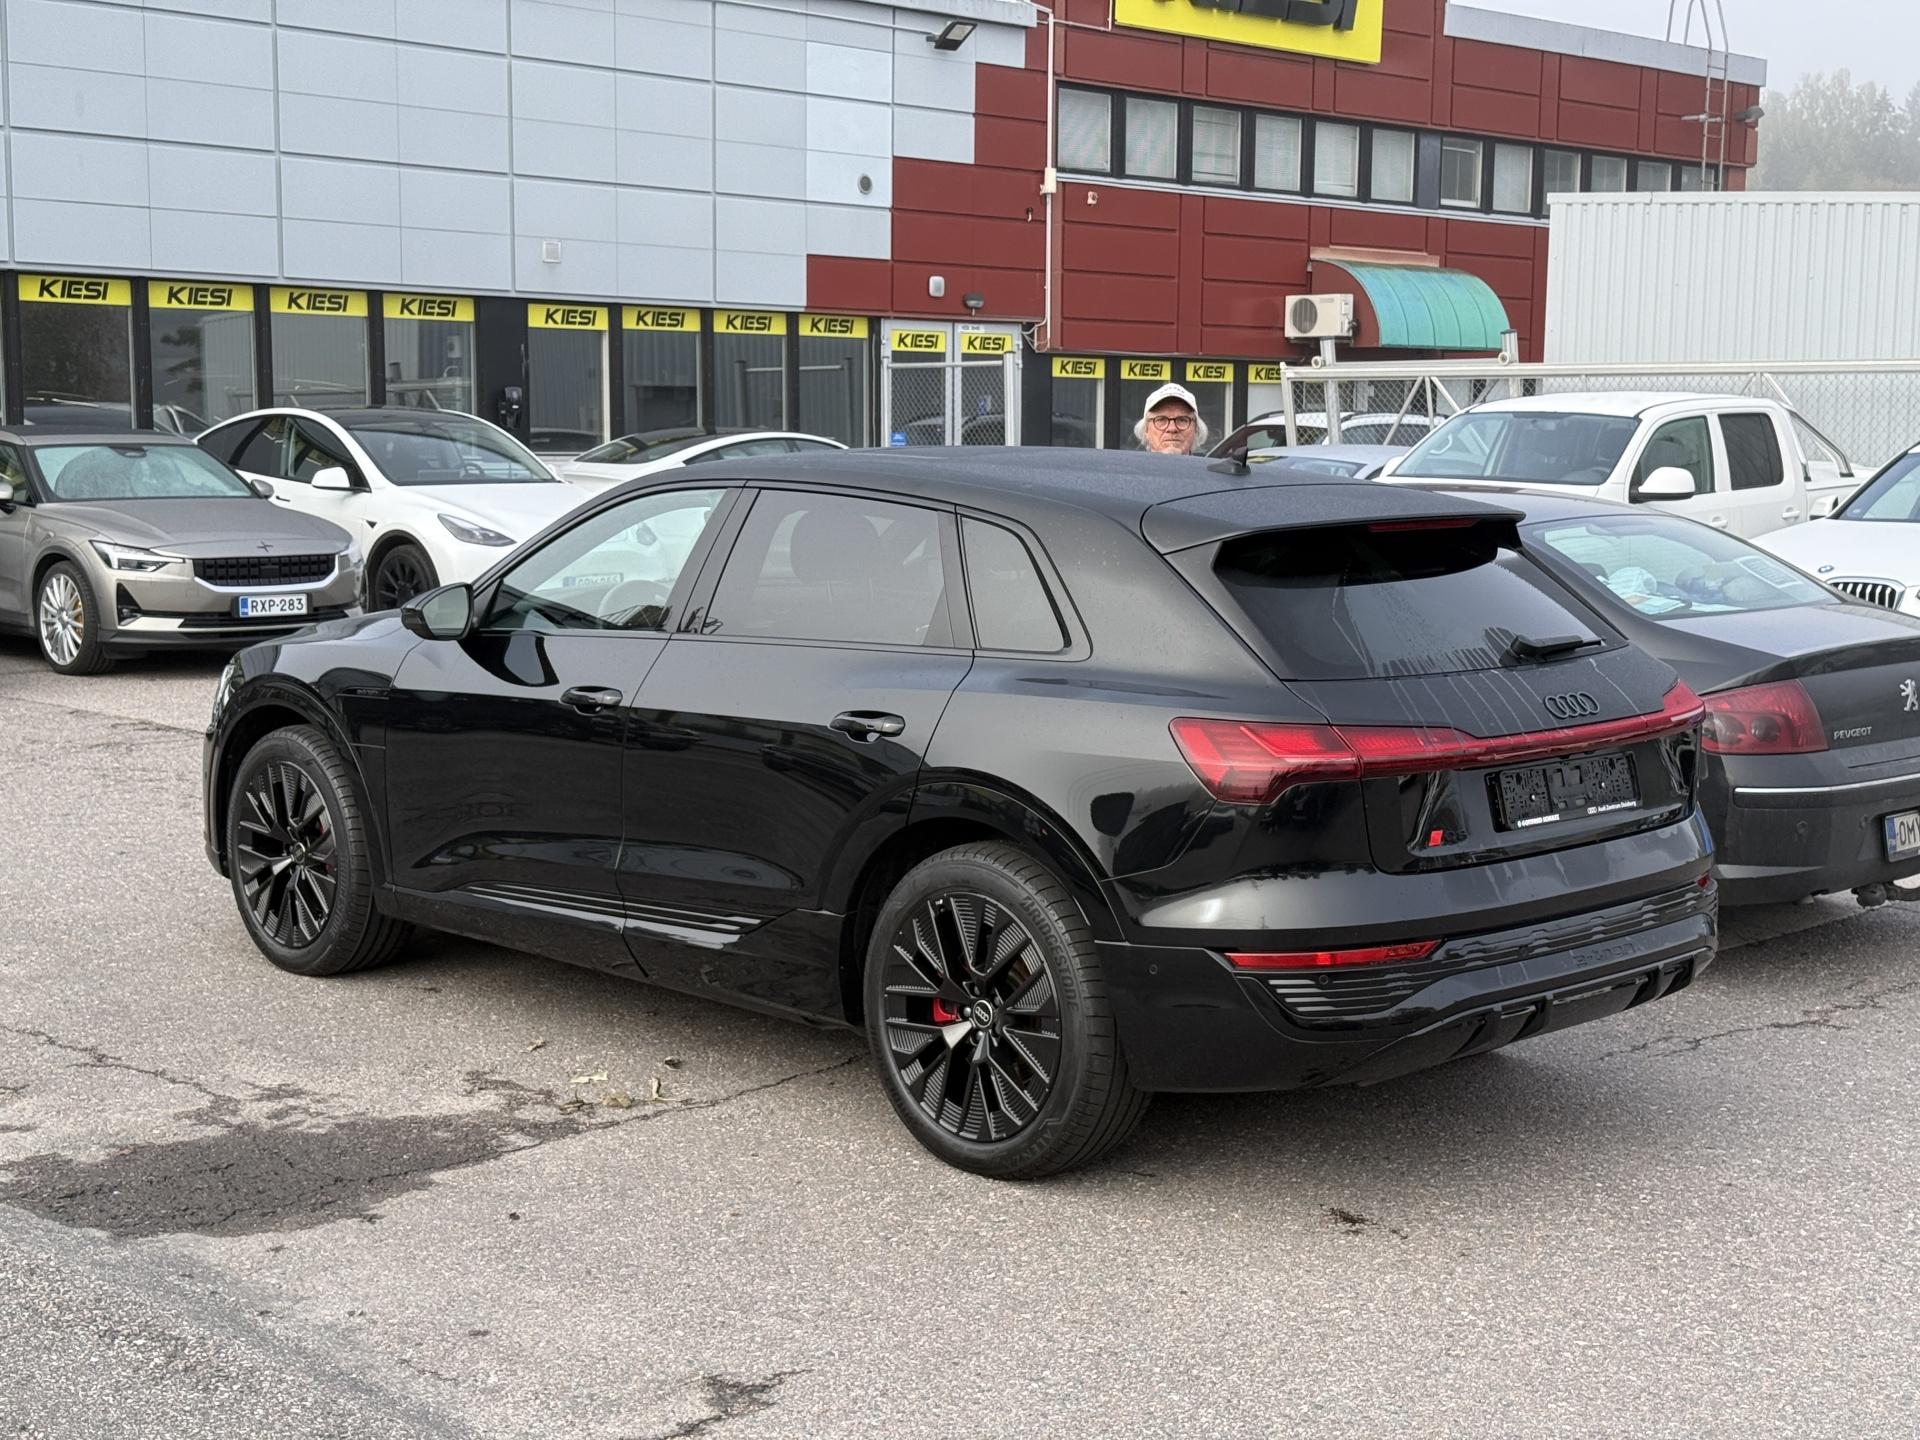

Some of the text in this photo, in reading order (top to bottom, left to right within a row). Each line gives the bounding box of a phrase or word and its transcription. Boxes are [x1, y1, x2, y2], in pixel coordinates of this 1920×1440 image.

[38, 279, 109, 300] KIESI
[167, 286, 233, 307] KIESI
[287, 292, 349, 312] KIESI
[400, 298, 457, 317] KIESI
[544, 308, 597, 326] KIESI
[636, 310, 685, 328] KIESI
[726, 314, 772, 331] KIESI
[810, 317, 854, 334] KIESI
[897, 333, 939, 349] KIESI
[967, 335, 1005, 351] KIESI
[1059, 360, 1096, 375] KIESI
[1127, 362, 1163, 377] KIESI
[1192, 365, 1226, 379] KIESI
[1254, 367, 1281, 380] KIES
[250, 598, 304, 613] RXP-283
[1833, 726, 1872, 740] PEUGEOT
[1019, 896, 1080, 1012] BRIDGESTONE
